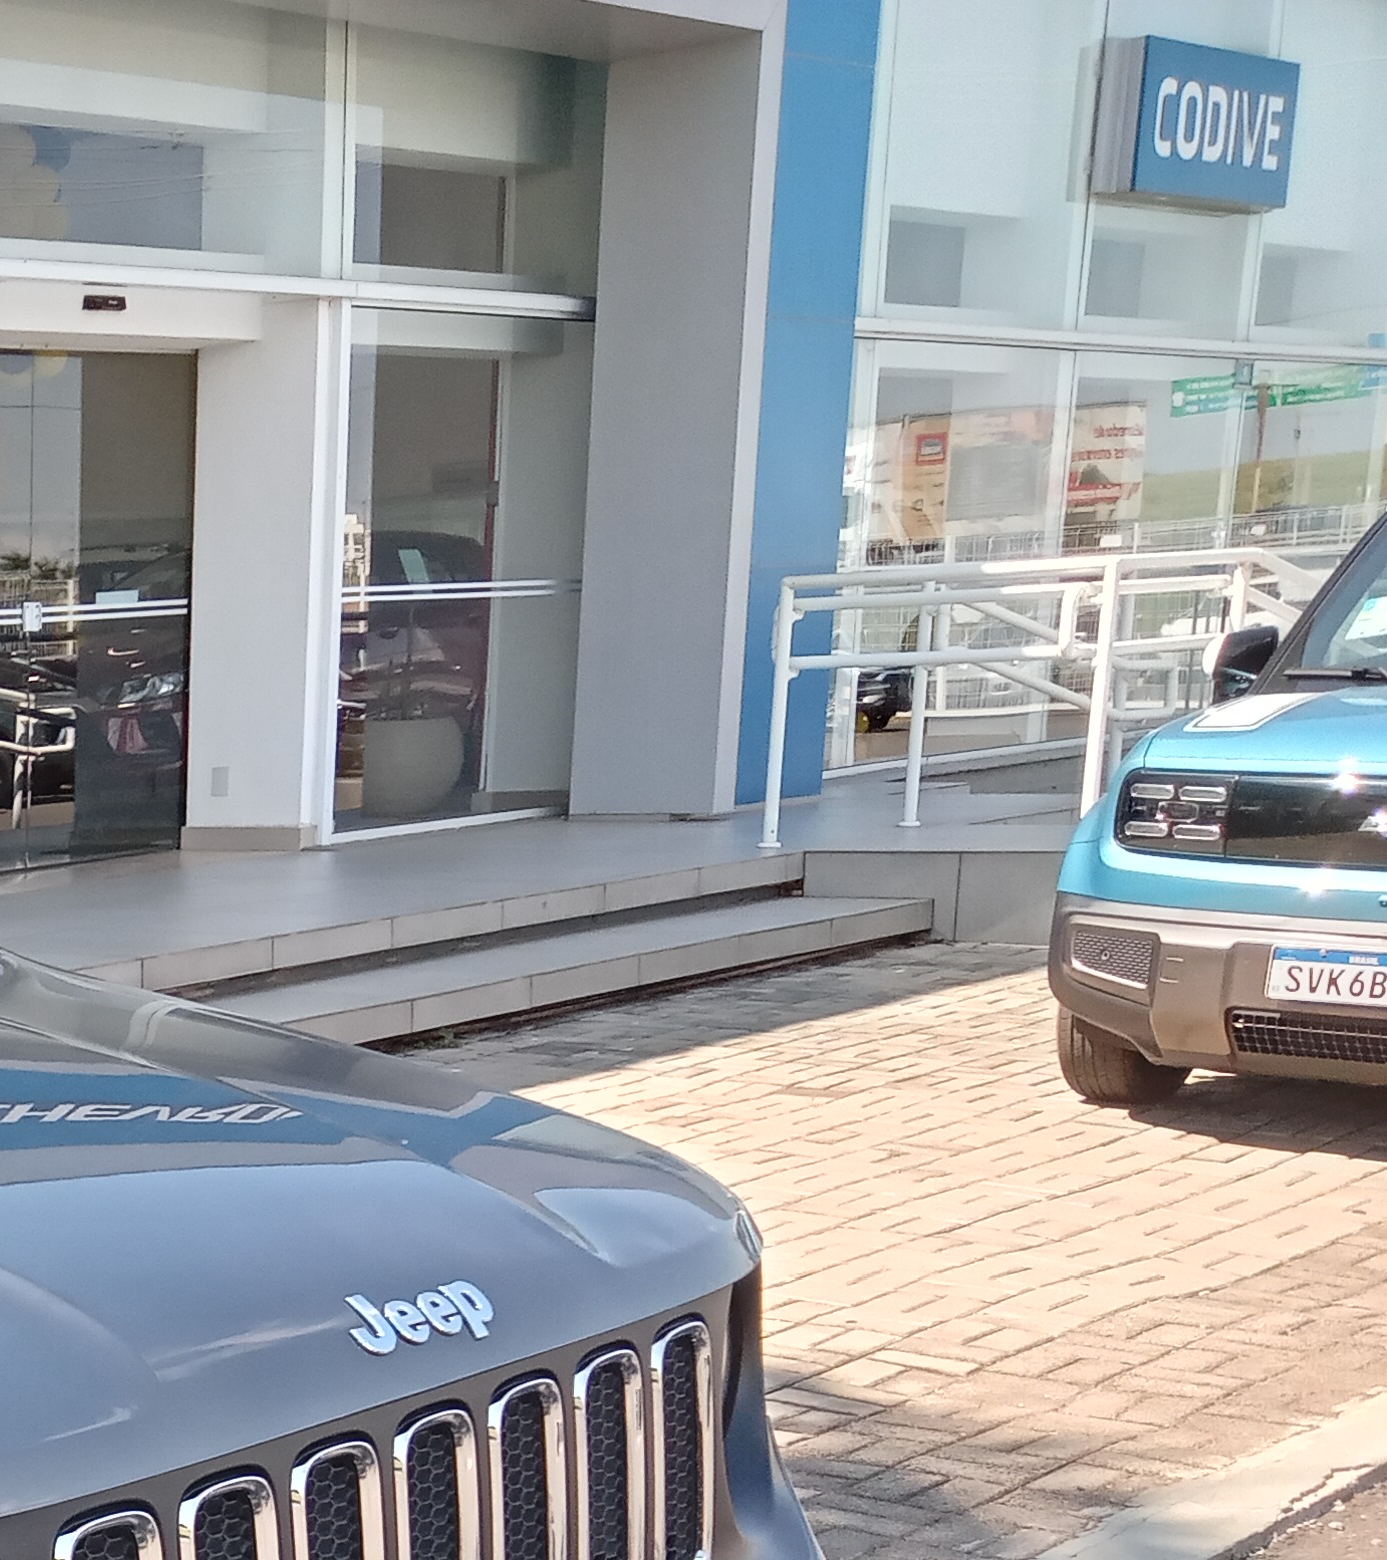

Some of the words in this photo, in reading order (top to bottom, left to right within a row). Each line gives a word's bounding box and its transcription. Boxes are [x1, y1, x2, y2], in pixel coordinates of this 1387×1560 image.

[1153, 76, 1286, 172] CODIVE
[1284, 965, 1387, 999] SVK6B
[343, 1279, 494, 1356] Jeep
